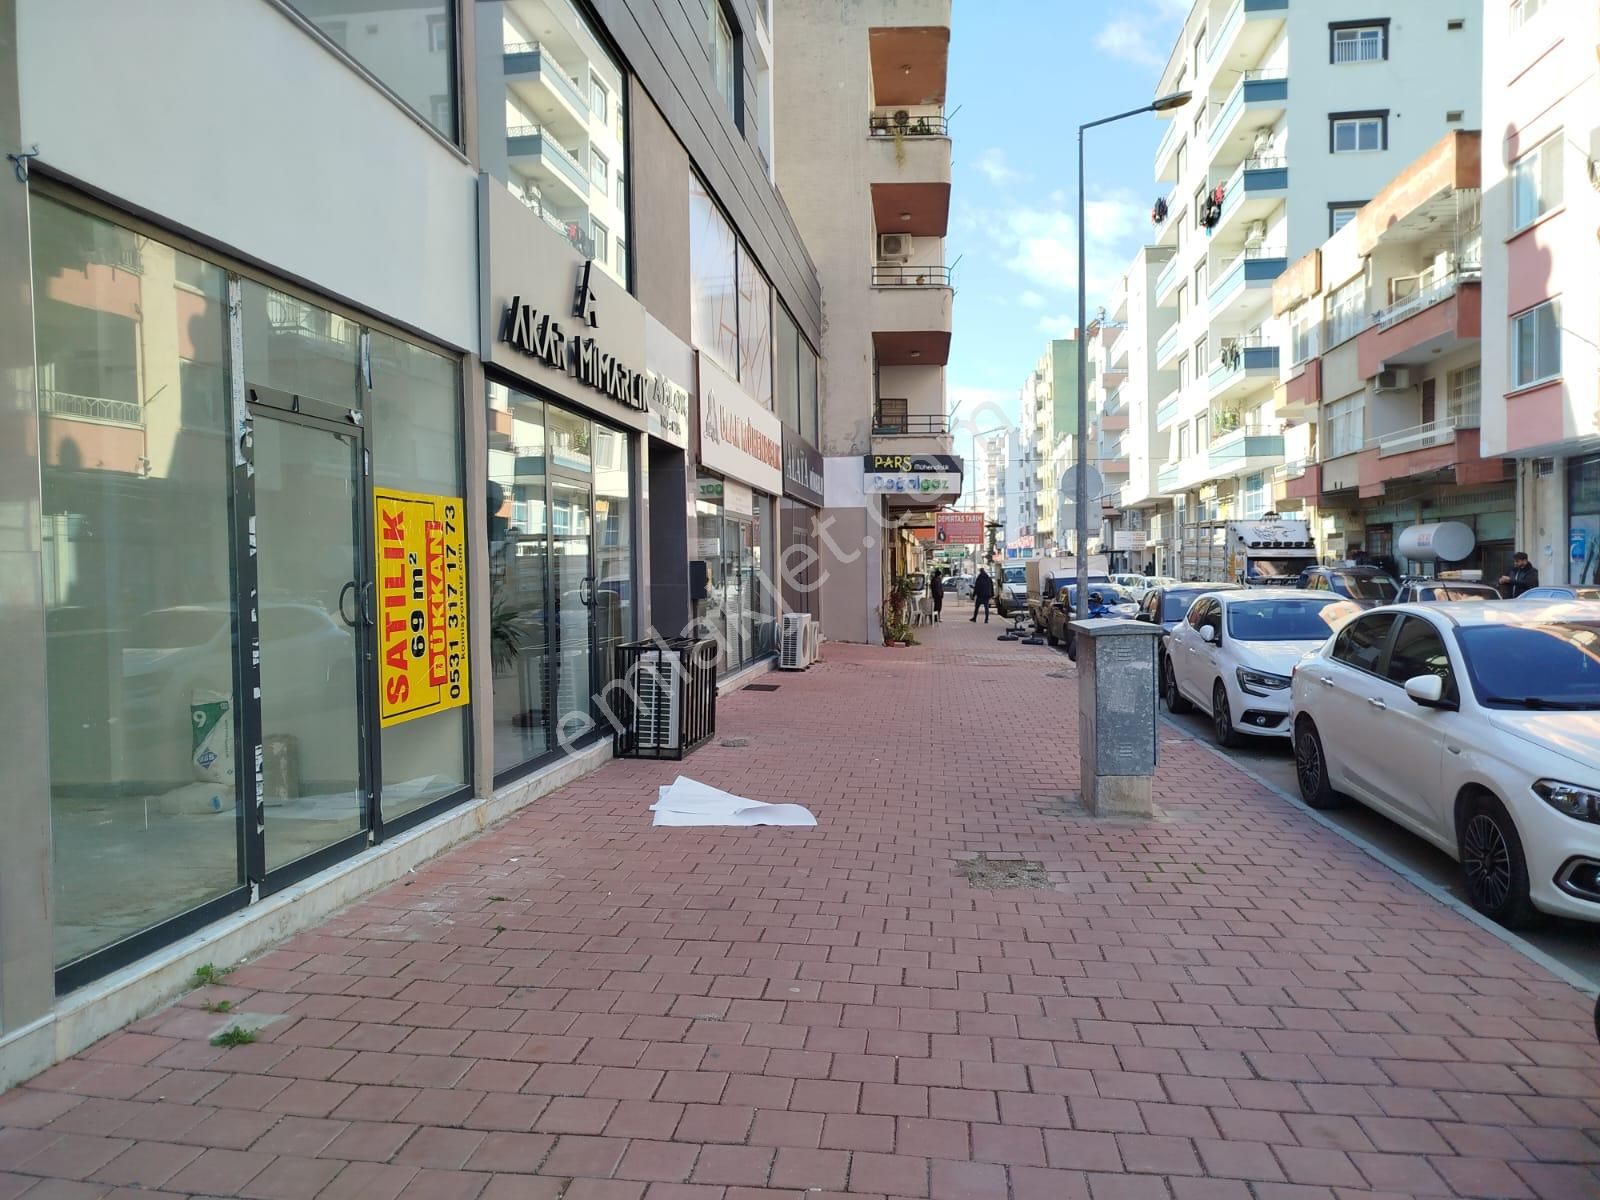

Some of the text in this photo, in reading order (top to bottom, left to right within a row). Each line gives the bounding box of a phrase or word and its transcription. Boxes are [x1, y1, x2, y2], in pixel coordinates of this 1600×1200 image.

[874, 456, 912, 472] PARS
[383, 509, 409, 705] SATILIK
[410, 610, 425, 658] 69
[429, 529, 446, 678] DÜKKAN
[444, 505, 461, 699] 0531 317 17 73
